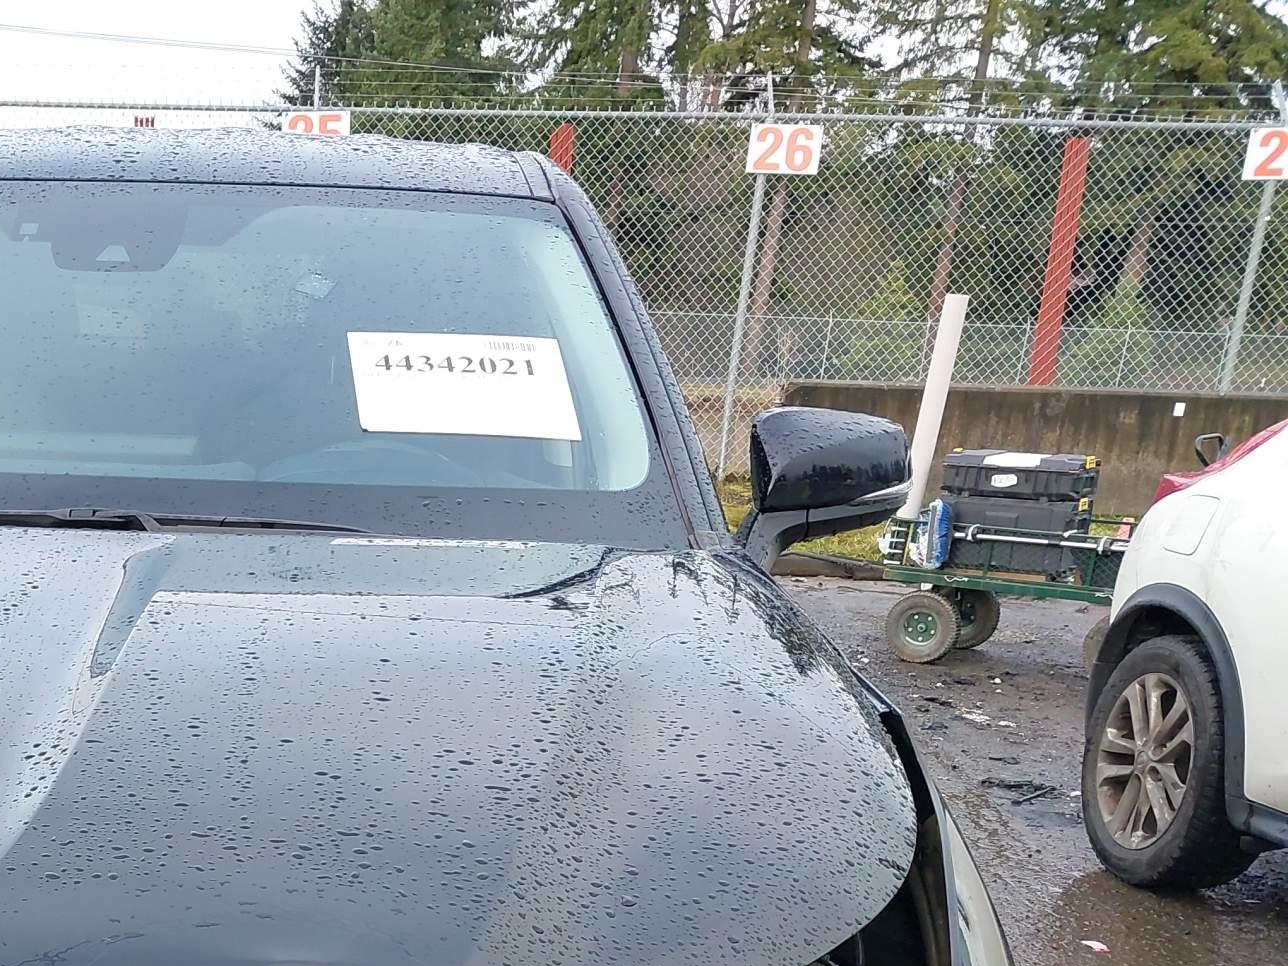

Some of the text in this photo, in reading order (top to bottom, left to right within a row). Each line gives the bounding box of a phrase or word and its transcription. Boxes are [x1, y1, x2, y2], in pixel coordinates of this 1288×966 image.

[753, 127, 814, 172] 26
[1253, 130, 1288, 176] 2
[375, 354, 535, 376] 44342021
